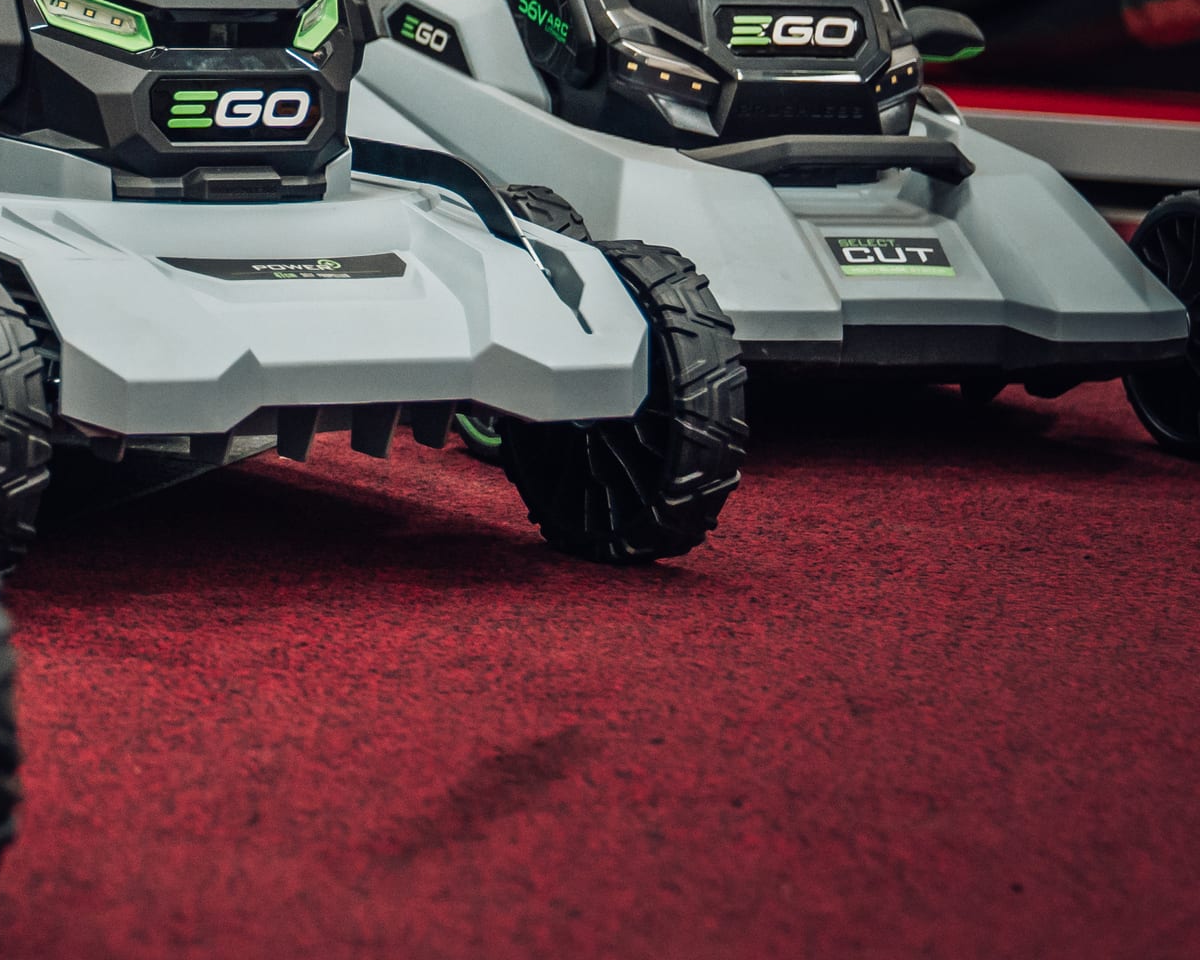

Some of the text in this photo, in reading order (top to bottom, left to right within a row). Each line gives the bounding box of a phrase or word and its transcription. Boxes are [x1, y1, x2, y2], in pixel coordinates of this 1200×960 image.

[400, 14, 449, 53] EGO
[547, 12, 569, 37] ARC
[730, 15, 856, 48] EGO
[167, 90, 311, 129] EGO
[838, 238, 896, 247] SELECT
[842, 247, 934, 263] CUT
